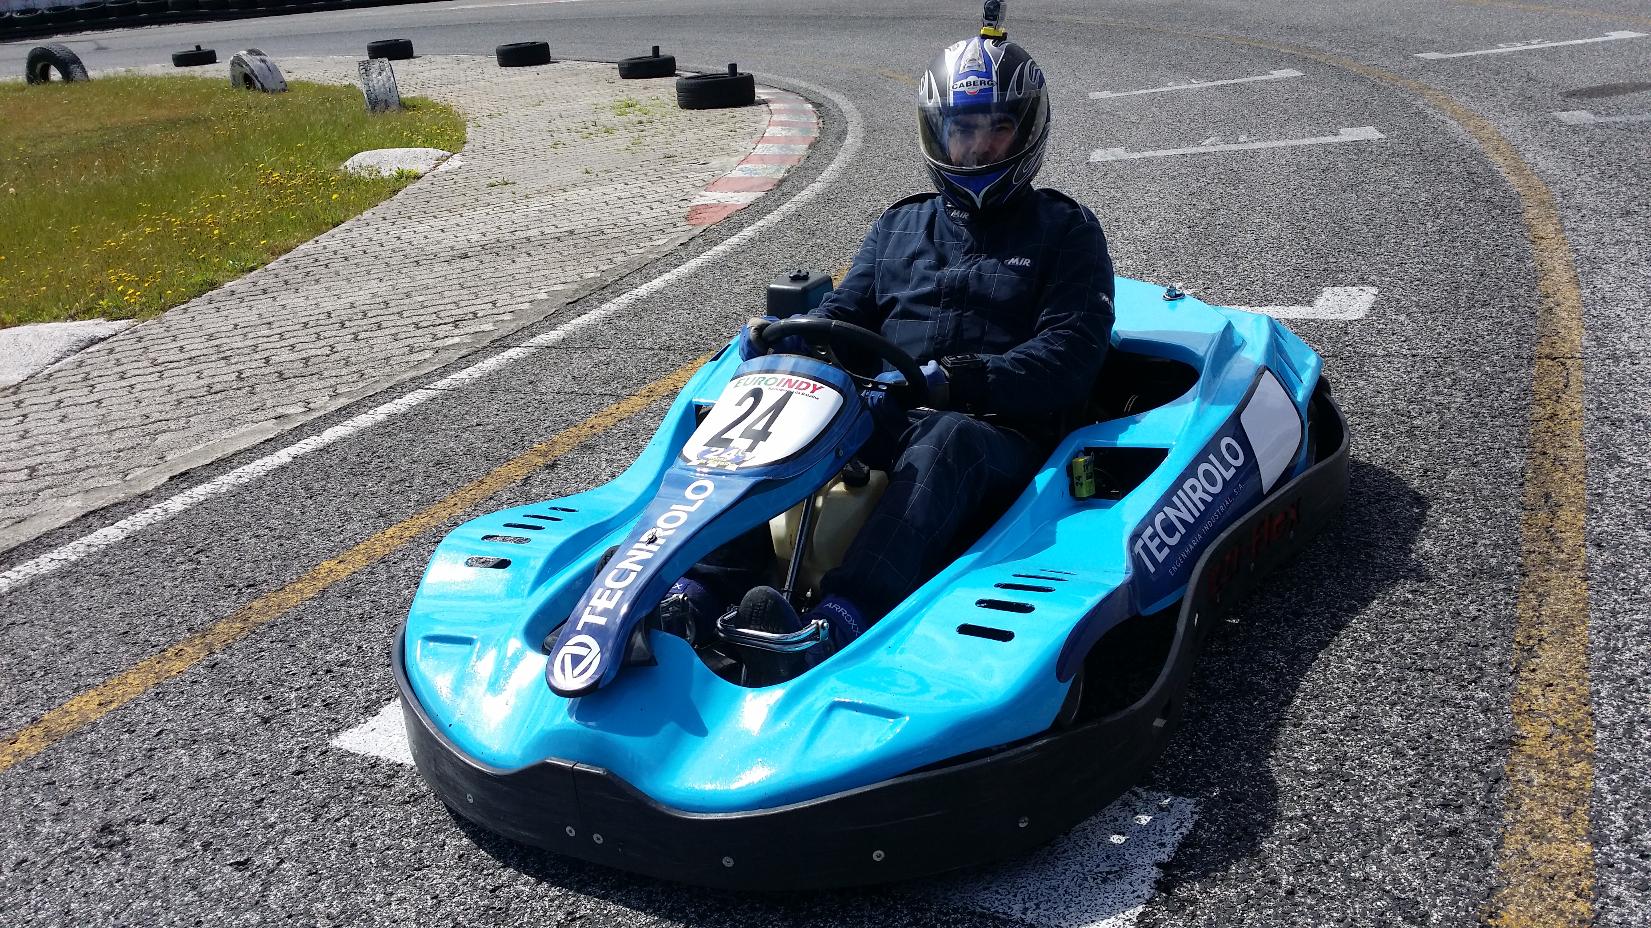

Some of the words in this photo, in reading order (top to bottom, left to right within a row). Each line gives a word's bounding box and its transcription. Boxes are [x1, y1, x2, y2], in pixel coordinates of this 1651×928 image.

[951, 78, 996, 90] CABERG
[950, 209, 970, 220] MIR
[1006, 256, 1032, 267] MIR
[734, 376, 825, 394] EUROINDY
[702, 387, 794, 453] 24
[1133, 436, 1245, 574] TECNIROLO
[575, 479, 716, 631] TECNIROLO
[1168, 533, 1202, 577] ENGENHARIA
[823, 602, 862, 637] ARROXX
